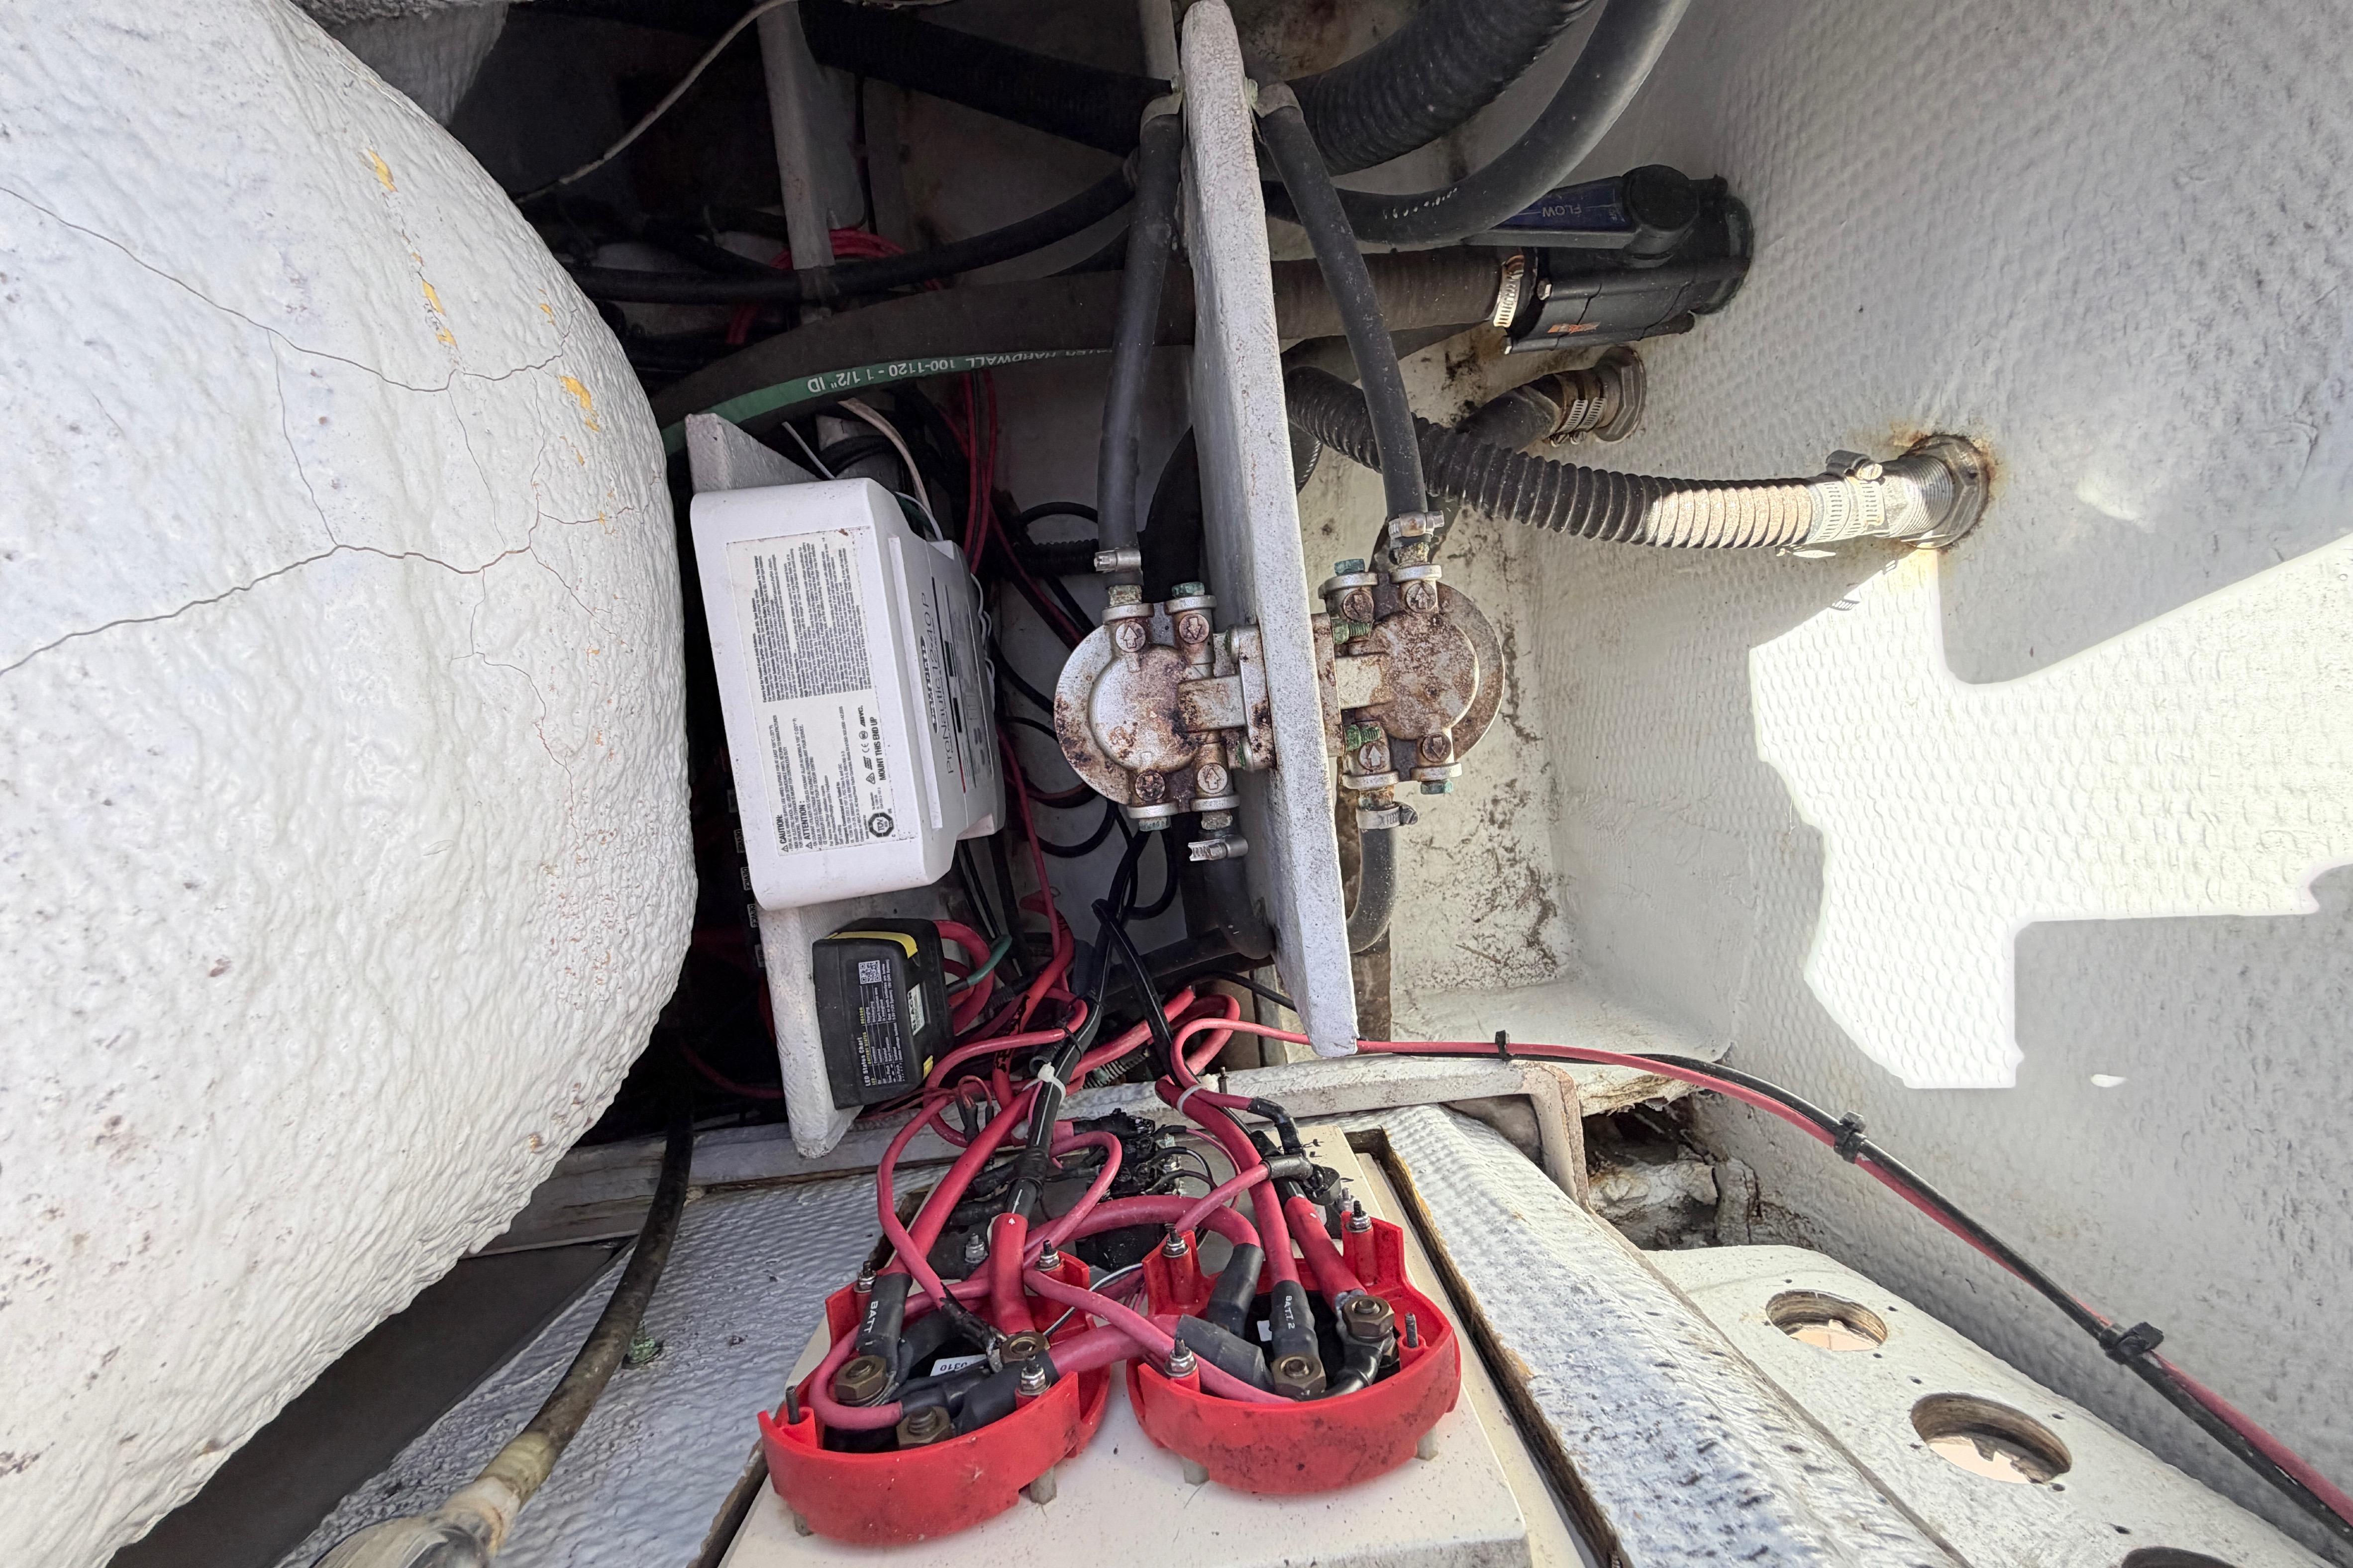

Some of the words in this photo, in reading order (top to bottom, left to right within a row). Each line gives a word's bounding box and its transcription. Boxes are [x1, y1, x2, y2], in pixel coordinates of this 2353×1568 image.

[1542, 204, 1582, 217] FLOW
[889, 359, 955, 377] 100-1120
[966, 350, 1056, 368] HARDWALL
[807, 376, 826, 393] ID
[830, 371, 861, 389] 1/2"
[921, 592, 929, 607] P
[924, 612, 938, 672] 12-40
[870, 716, 878, 726] UP
[936, 678, 954, 774] ProNautic
[874, 742, 882, 756] THIS
[876, 757, 886, 781] MOUNT
[776, 814, 787, 844] CAUTION:
[799, 804, 811, 840] ATTENTION
[742, 867, 751, 889] DEVICE
[749, 905, 758, 927] DEVICE
